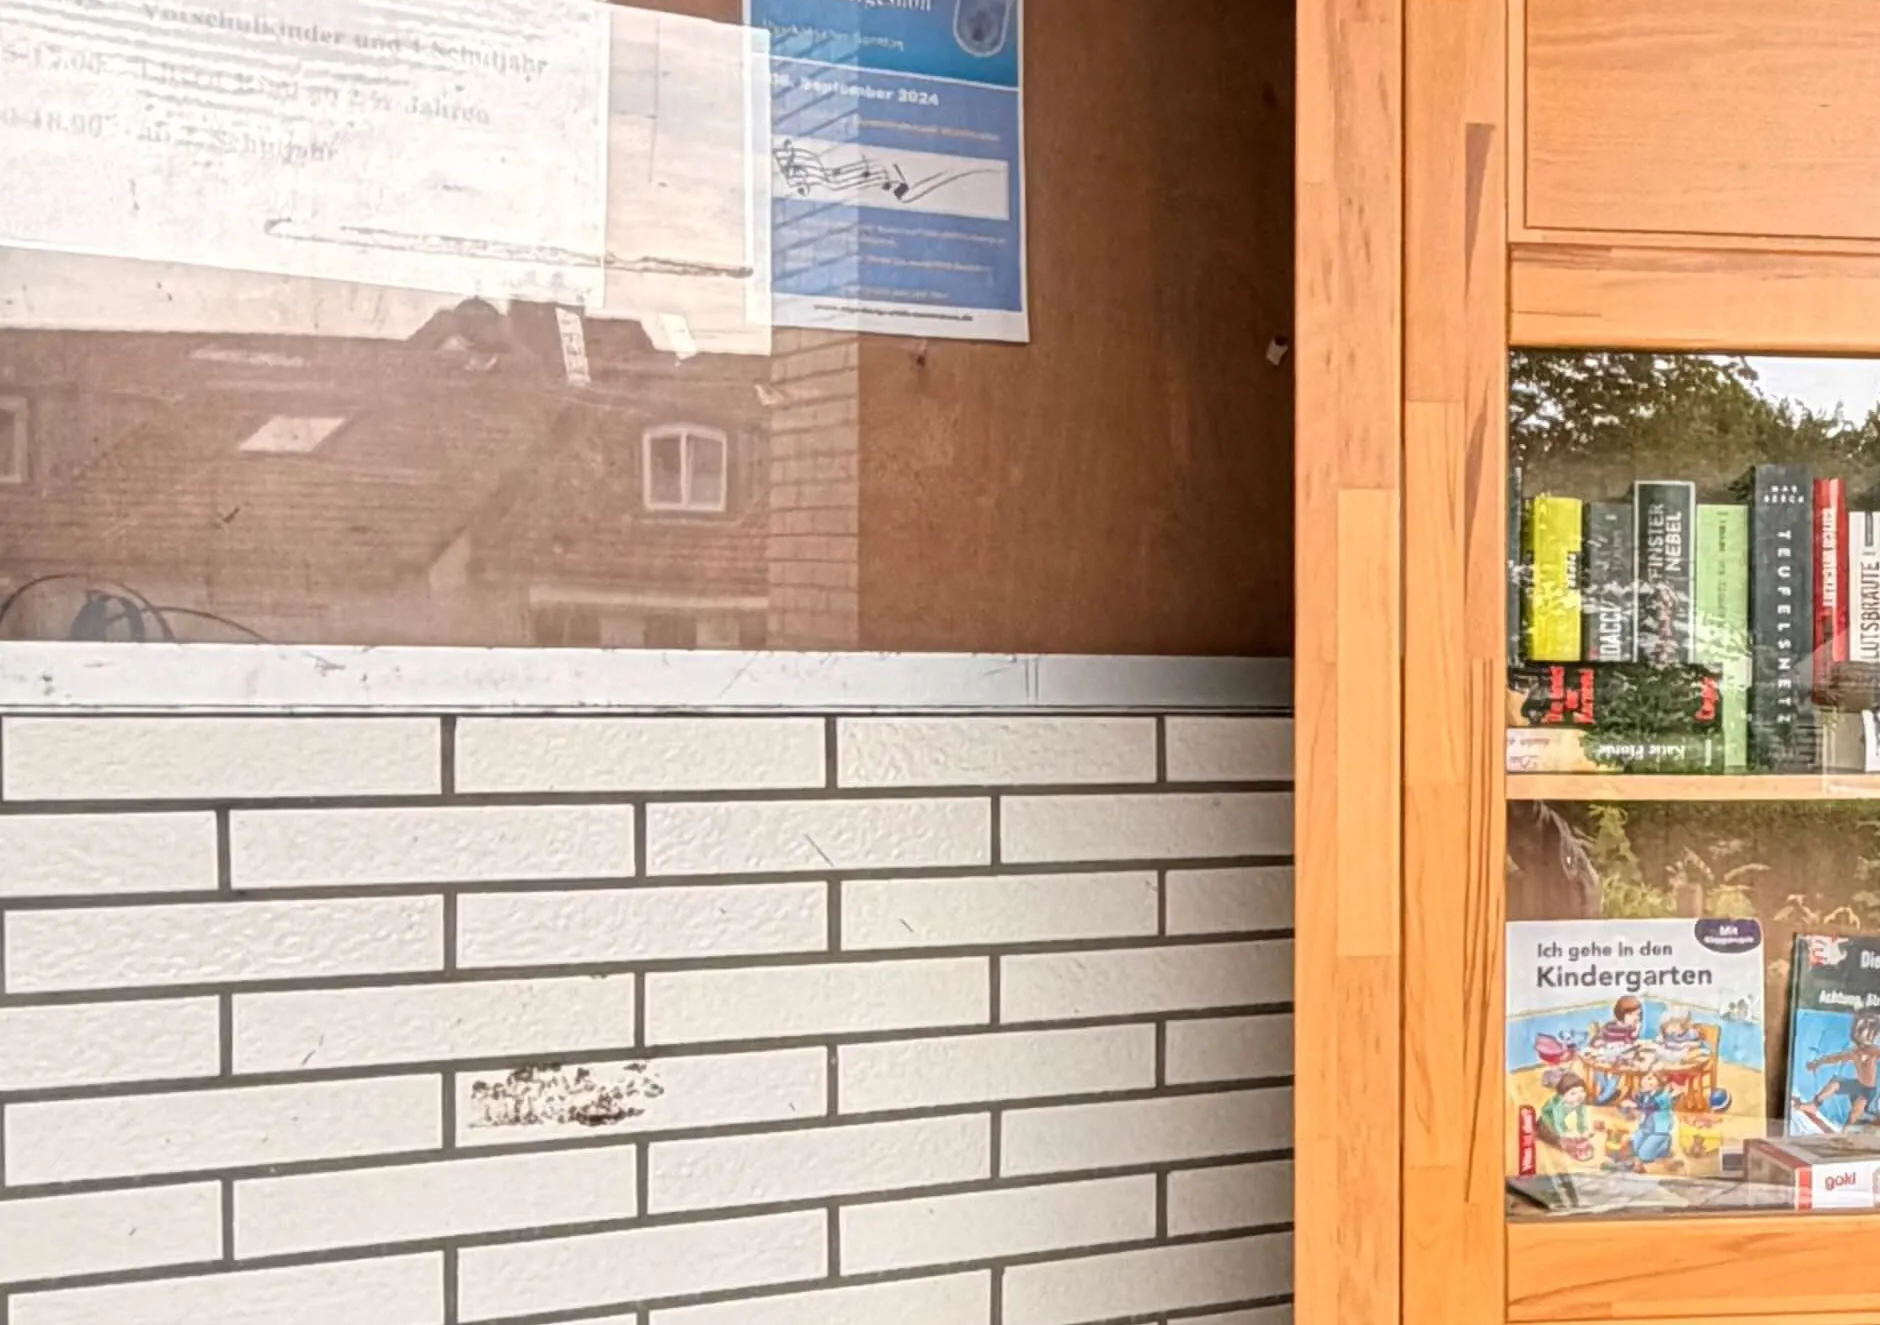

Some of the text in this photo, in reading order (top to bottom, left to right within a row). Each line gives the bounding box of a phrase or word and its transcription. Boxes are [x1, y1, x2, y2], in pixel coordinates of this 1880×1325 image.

[897, 88, 940, 107] 2024
[1665, 511, 1682, 572] NEBEL
[1777, 530, 1791, 723] TEUFELSNETZ
[1861, 560, 1880, 660] LUTSBRÄUTE
[1536, 940, 1673, 962] Ich gehe in den
[1536, 963, 1713, 993] Kindergarten
